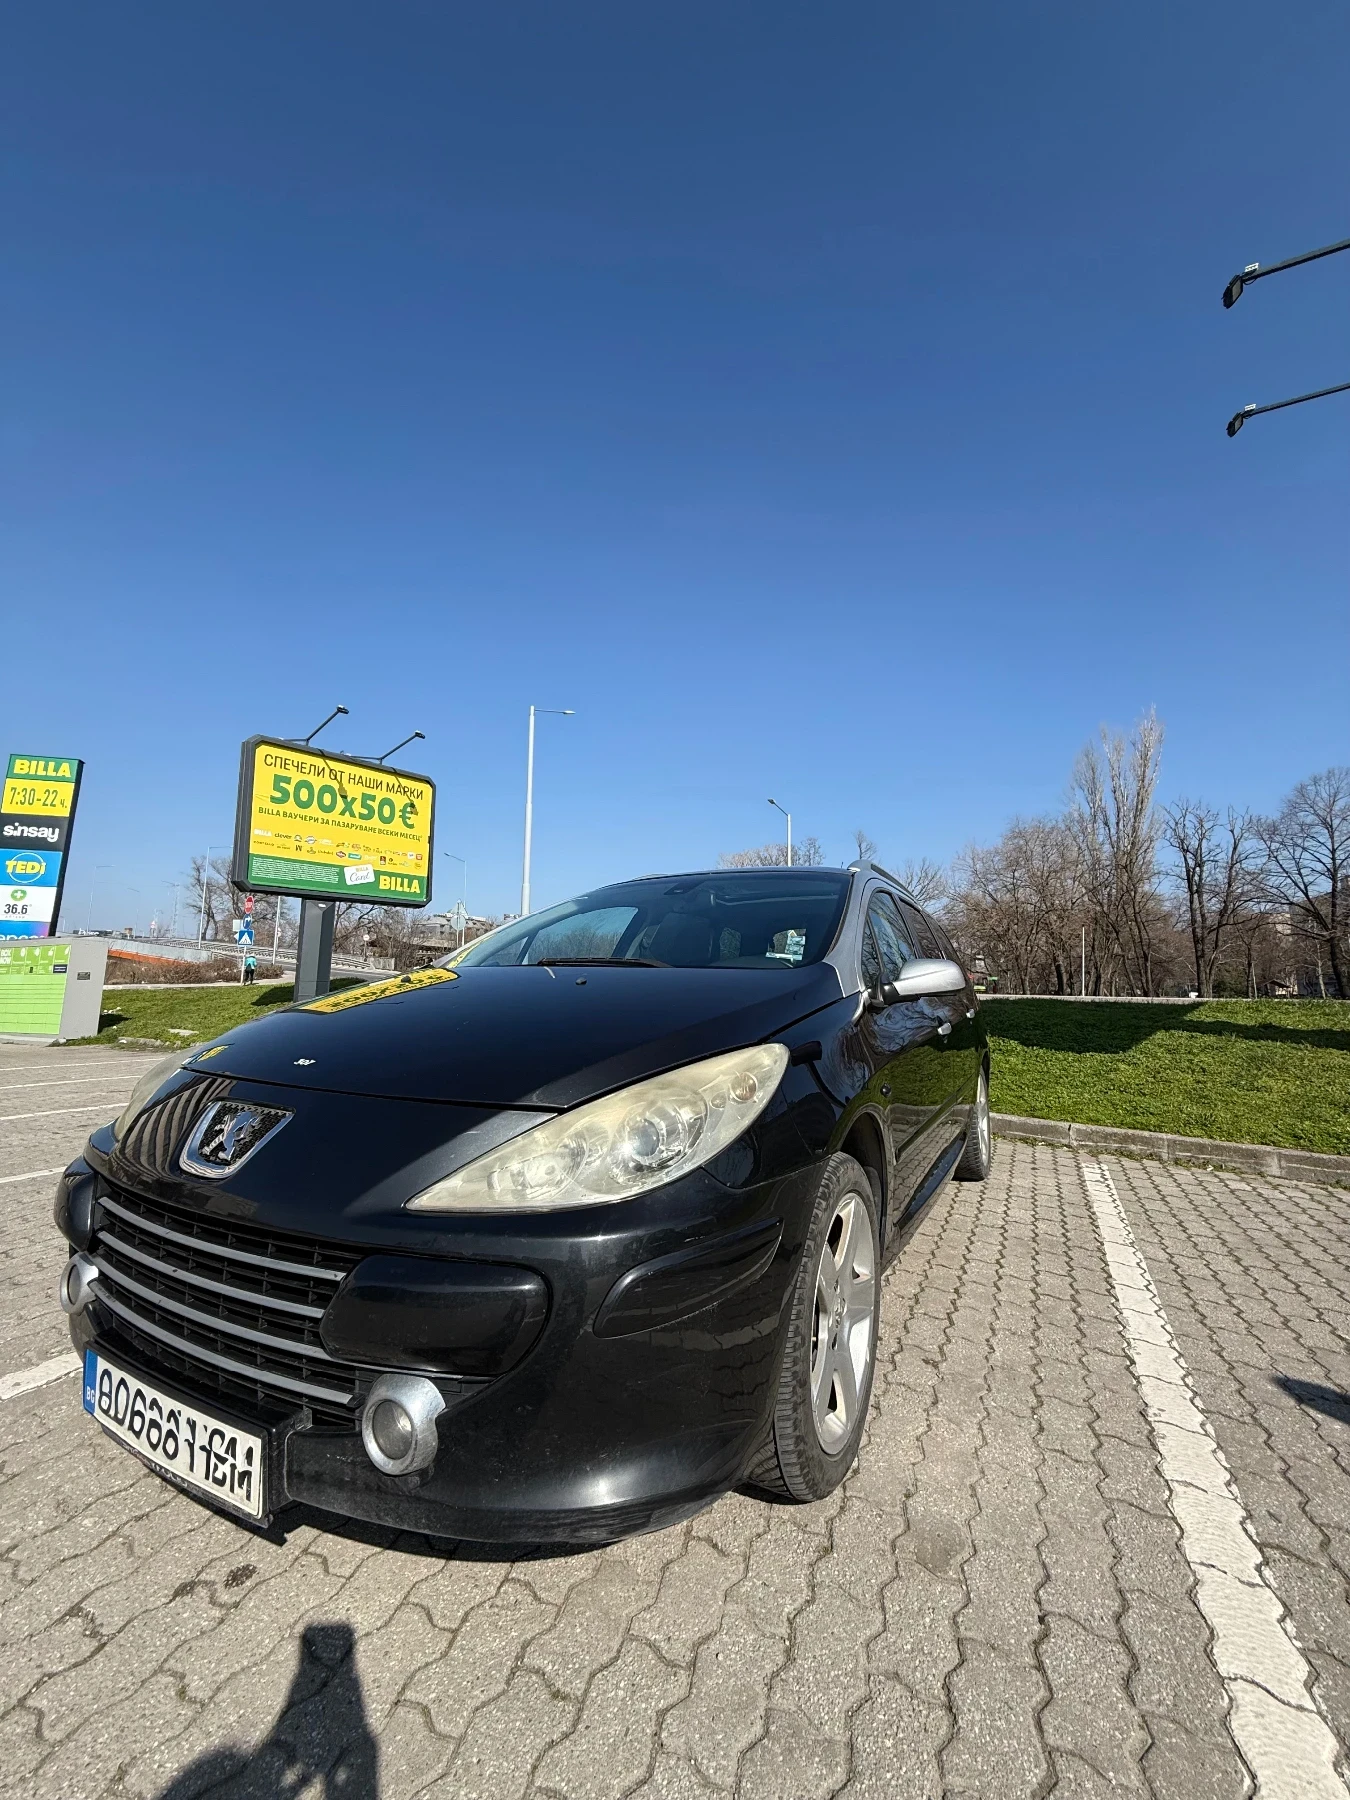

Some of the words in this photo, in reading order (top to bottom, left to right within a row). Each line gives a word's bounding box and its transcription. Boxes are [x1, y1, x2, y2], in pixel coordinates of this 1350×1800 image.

[13, 759, 71, 777] BILLA
[264, 754, 325, 778] СПЕЧЕЛИ
[329, 768, 345, 782] ОТ
[348, 773, 383, 791] НАШИ
[386, 782, 423, 800] МАРКИ
[9, 787, 58, 807] 7:30-22
[3, 822, 59, 842] sinsay
[258, 807, 280, 817] BILLA
[282, 812, 319, 824] ВАУЧЕРИ
[320, 818, 330, 826] ЗА
[331, 820, 377, 833] ПАЗАРУВАНЕ
[378, 828, 399, 838] ВСЕКИ
[350, 872, 370, 882] Card
[379, 875, 420, 893] BILLA
[86, 1386, 95, 1404] BG
